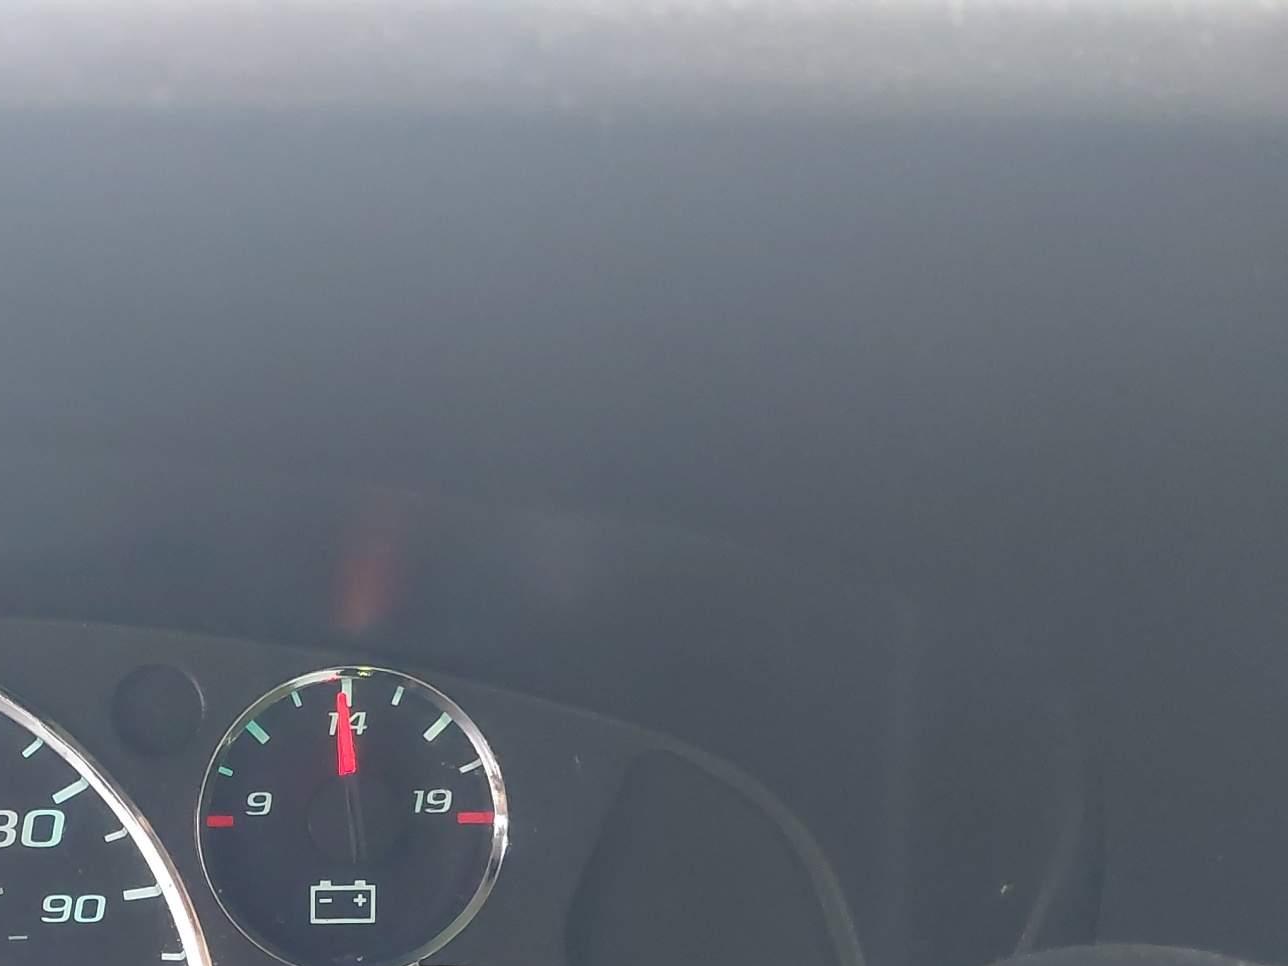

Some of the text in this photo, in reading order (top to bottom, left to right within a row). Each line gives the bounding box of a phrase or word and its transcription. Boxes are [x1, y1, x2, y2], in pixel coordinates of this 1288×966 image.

[328, 711, 367, 735] 14
[245, 791, 272, 816] 9
[413, 789, 452, 813] 19
[41, 894, 106, 923] 90
